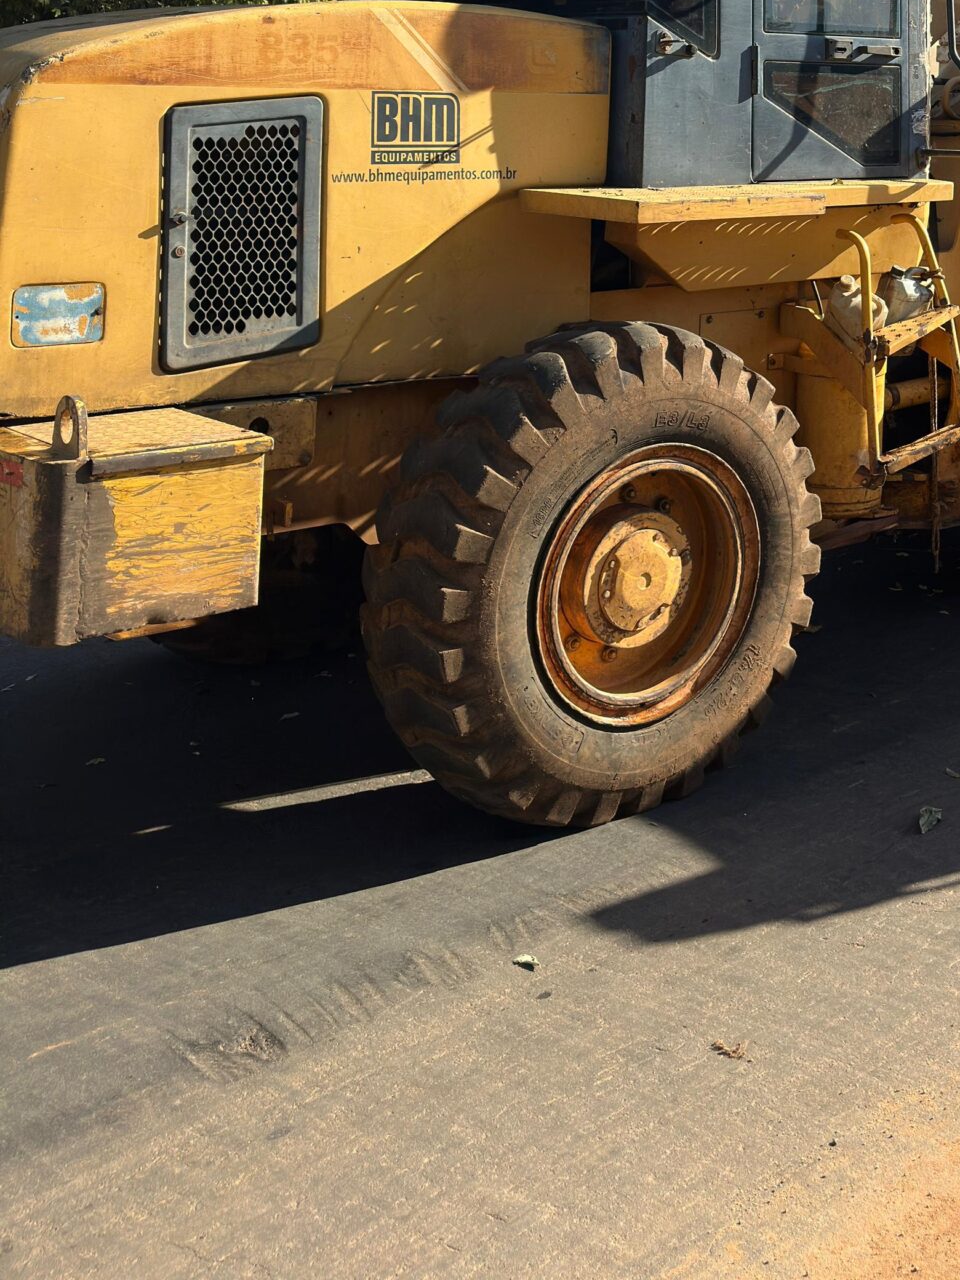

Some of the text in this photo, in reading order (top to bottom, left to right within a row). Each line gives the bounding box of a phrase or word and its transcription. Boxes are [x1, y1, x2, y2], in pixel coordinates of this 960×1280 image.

[376, 96, 456, 142] BHM
[375, 152, 457, 163] EQUIPAMENTOS
[331, 167, 517, 185] www.bhmequipamentos.com.br
